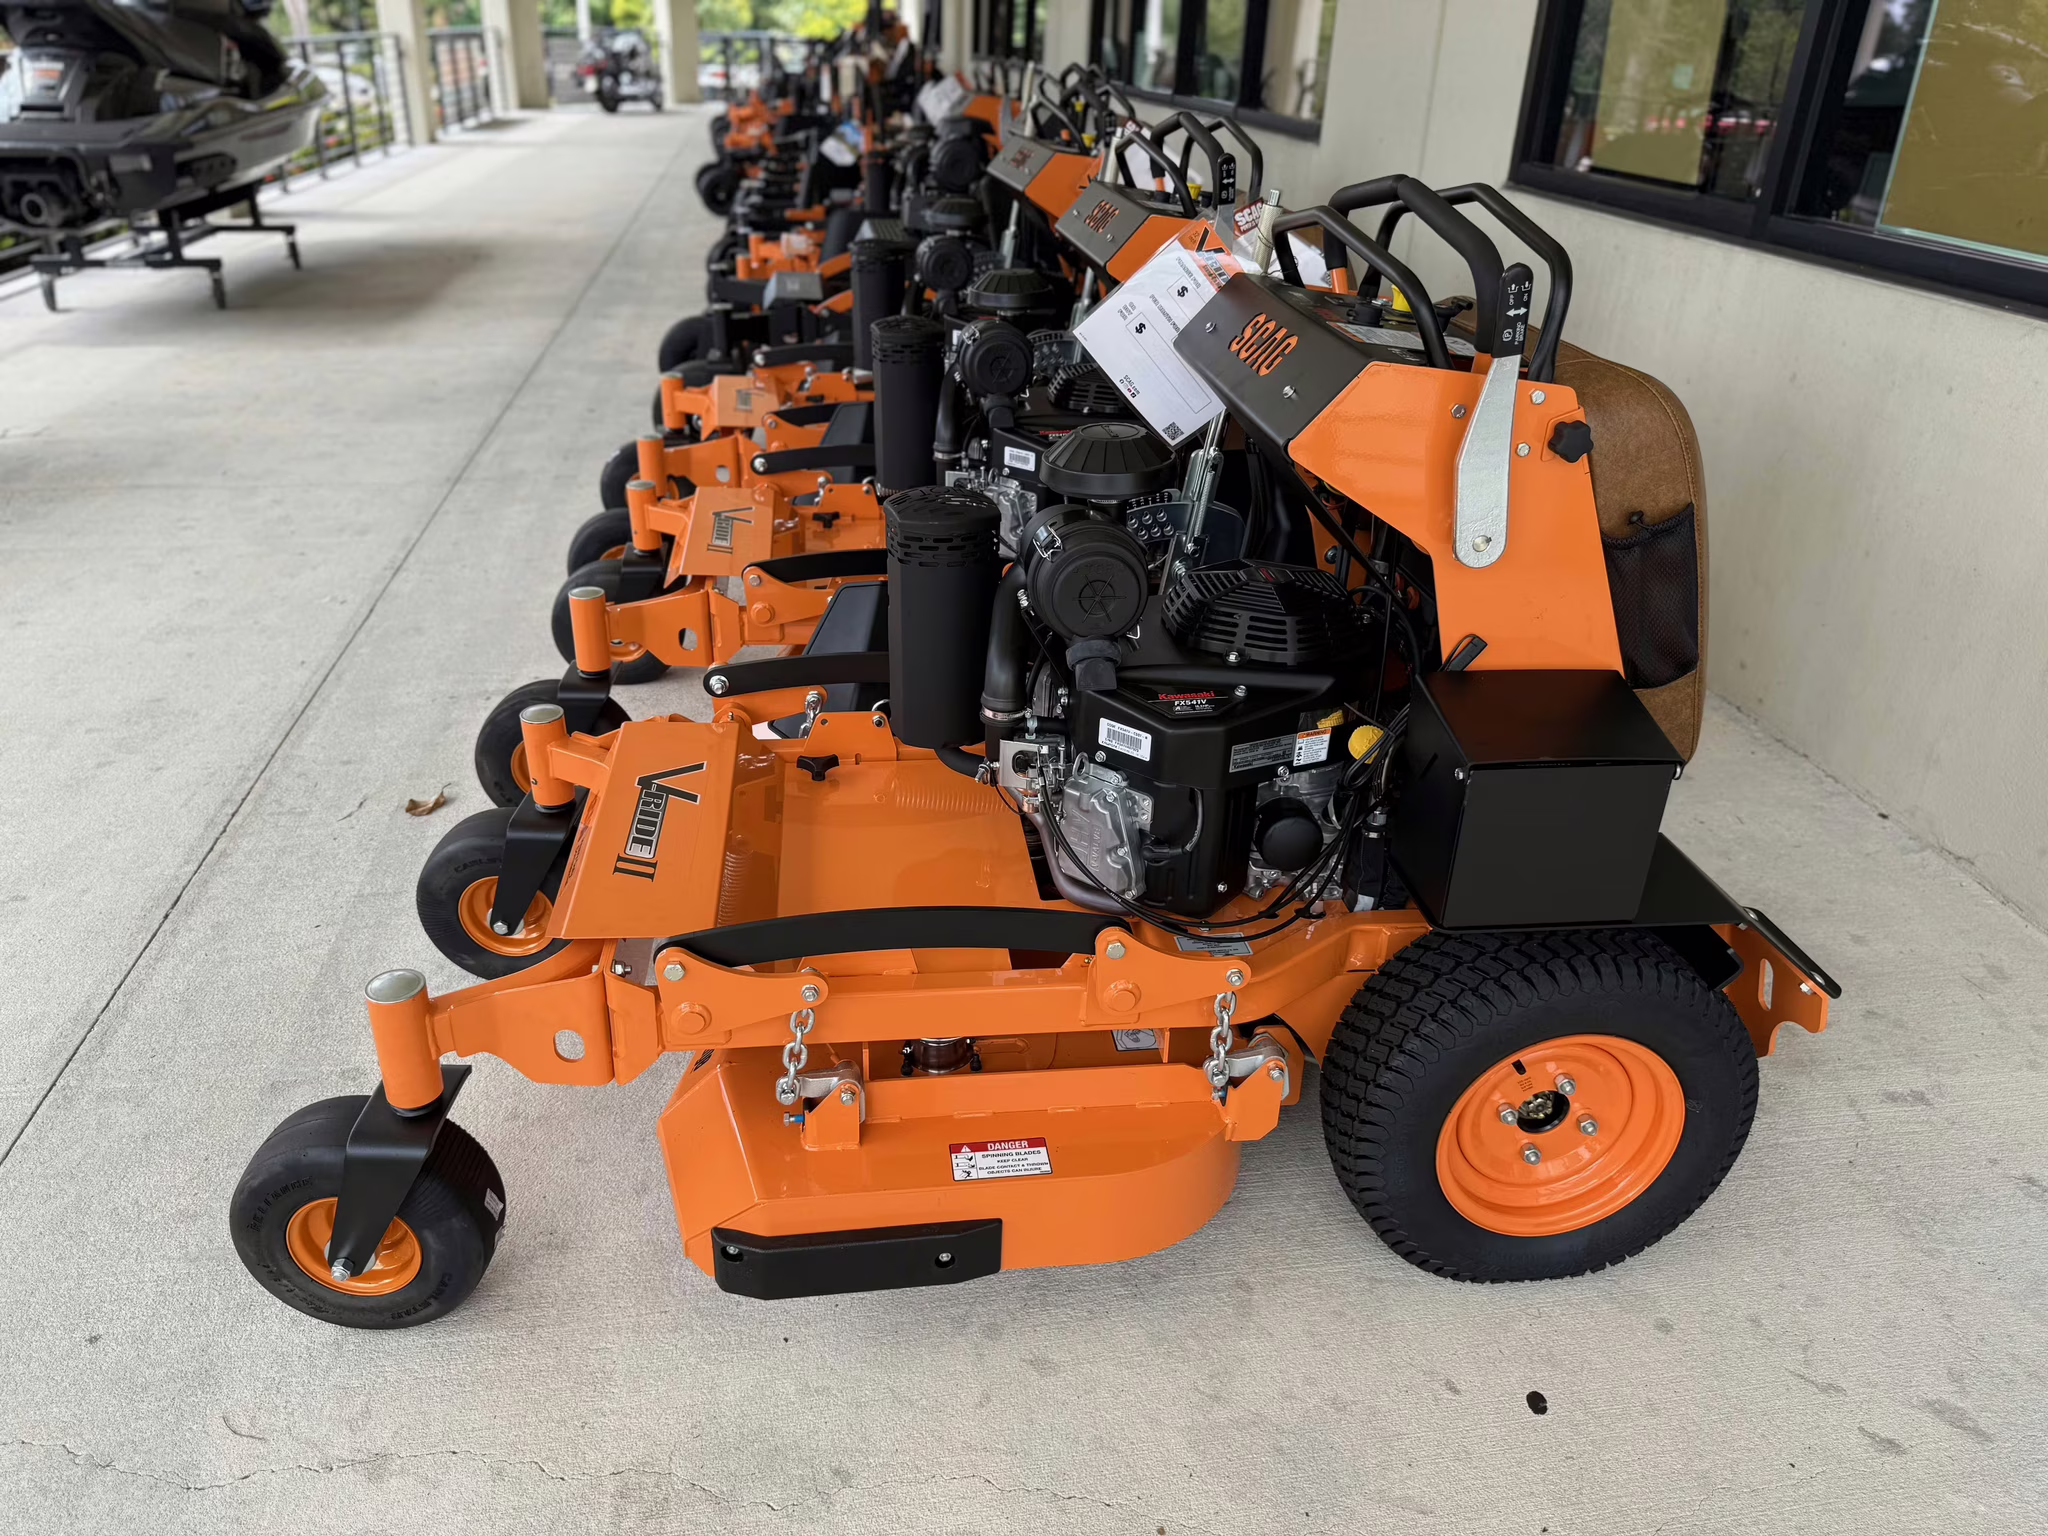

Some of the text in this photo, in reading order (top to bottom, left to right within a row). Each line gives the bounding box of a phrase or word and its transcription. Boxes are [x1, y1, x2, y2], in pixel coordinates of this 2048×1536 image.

[1177, 285, 1188, 298] $
[1135, 322, 1146, 334] $
[1228, 312, 1298, 376] SCAG
[1158, 690, 1216, 700] Kawasaki
[988, 1140, 1028, 1151] DANGER
